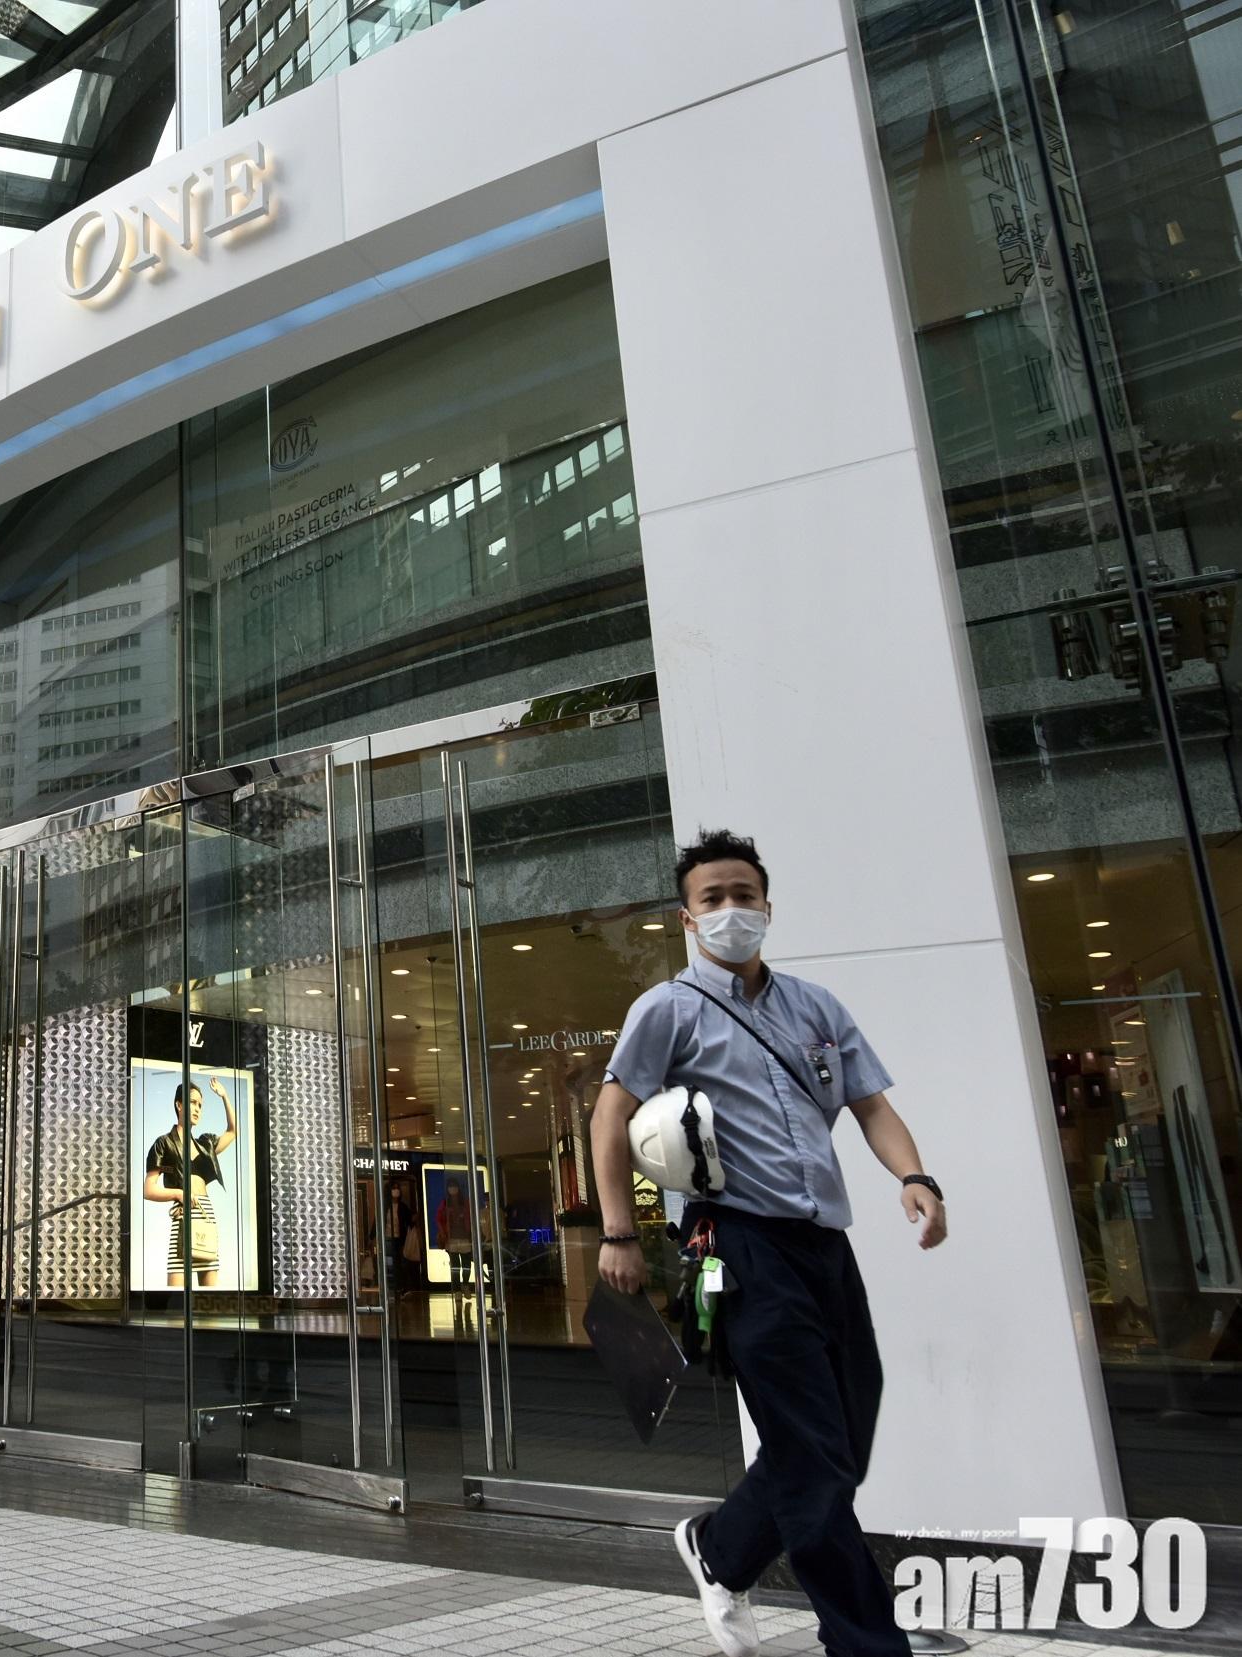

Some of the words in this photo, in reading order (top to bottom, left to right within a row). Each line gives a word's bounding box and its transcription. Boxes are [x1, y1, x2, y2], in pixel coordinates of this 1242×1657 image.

[60, 140, 270, 300] ONE
[235, 520, 275, 550] ITALIAN
[277, 483, 356, 529] PASTICCERIA
[308, 495, 377, 535] ELEGANCE
[250, 567, 303, 601] OPENING
[305, 551, 344, 577] SOON
[353, 1158, 409, 1171] CHAMET
